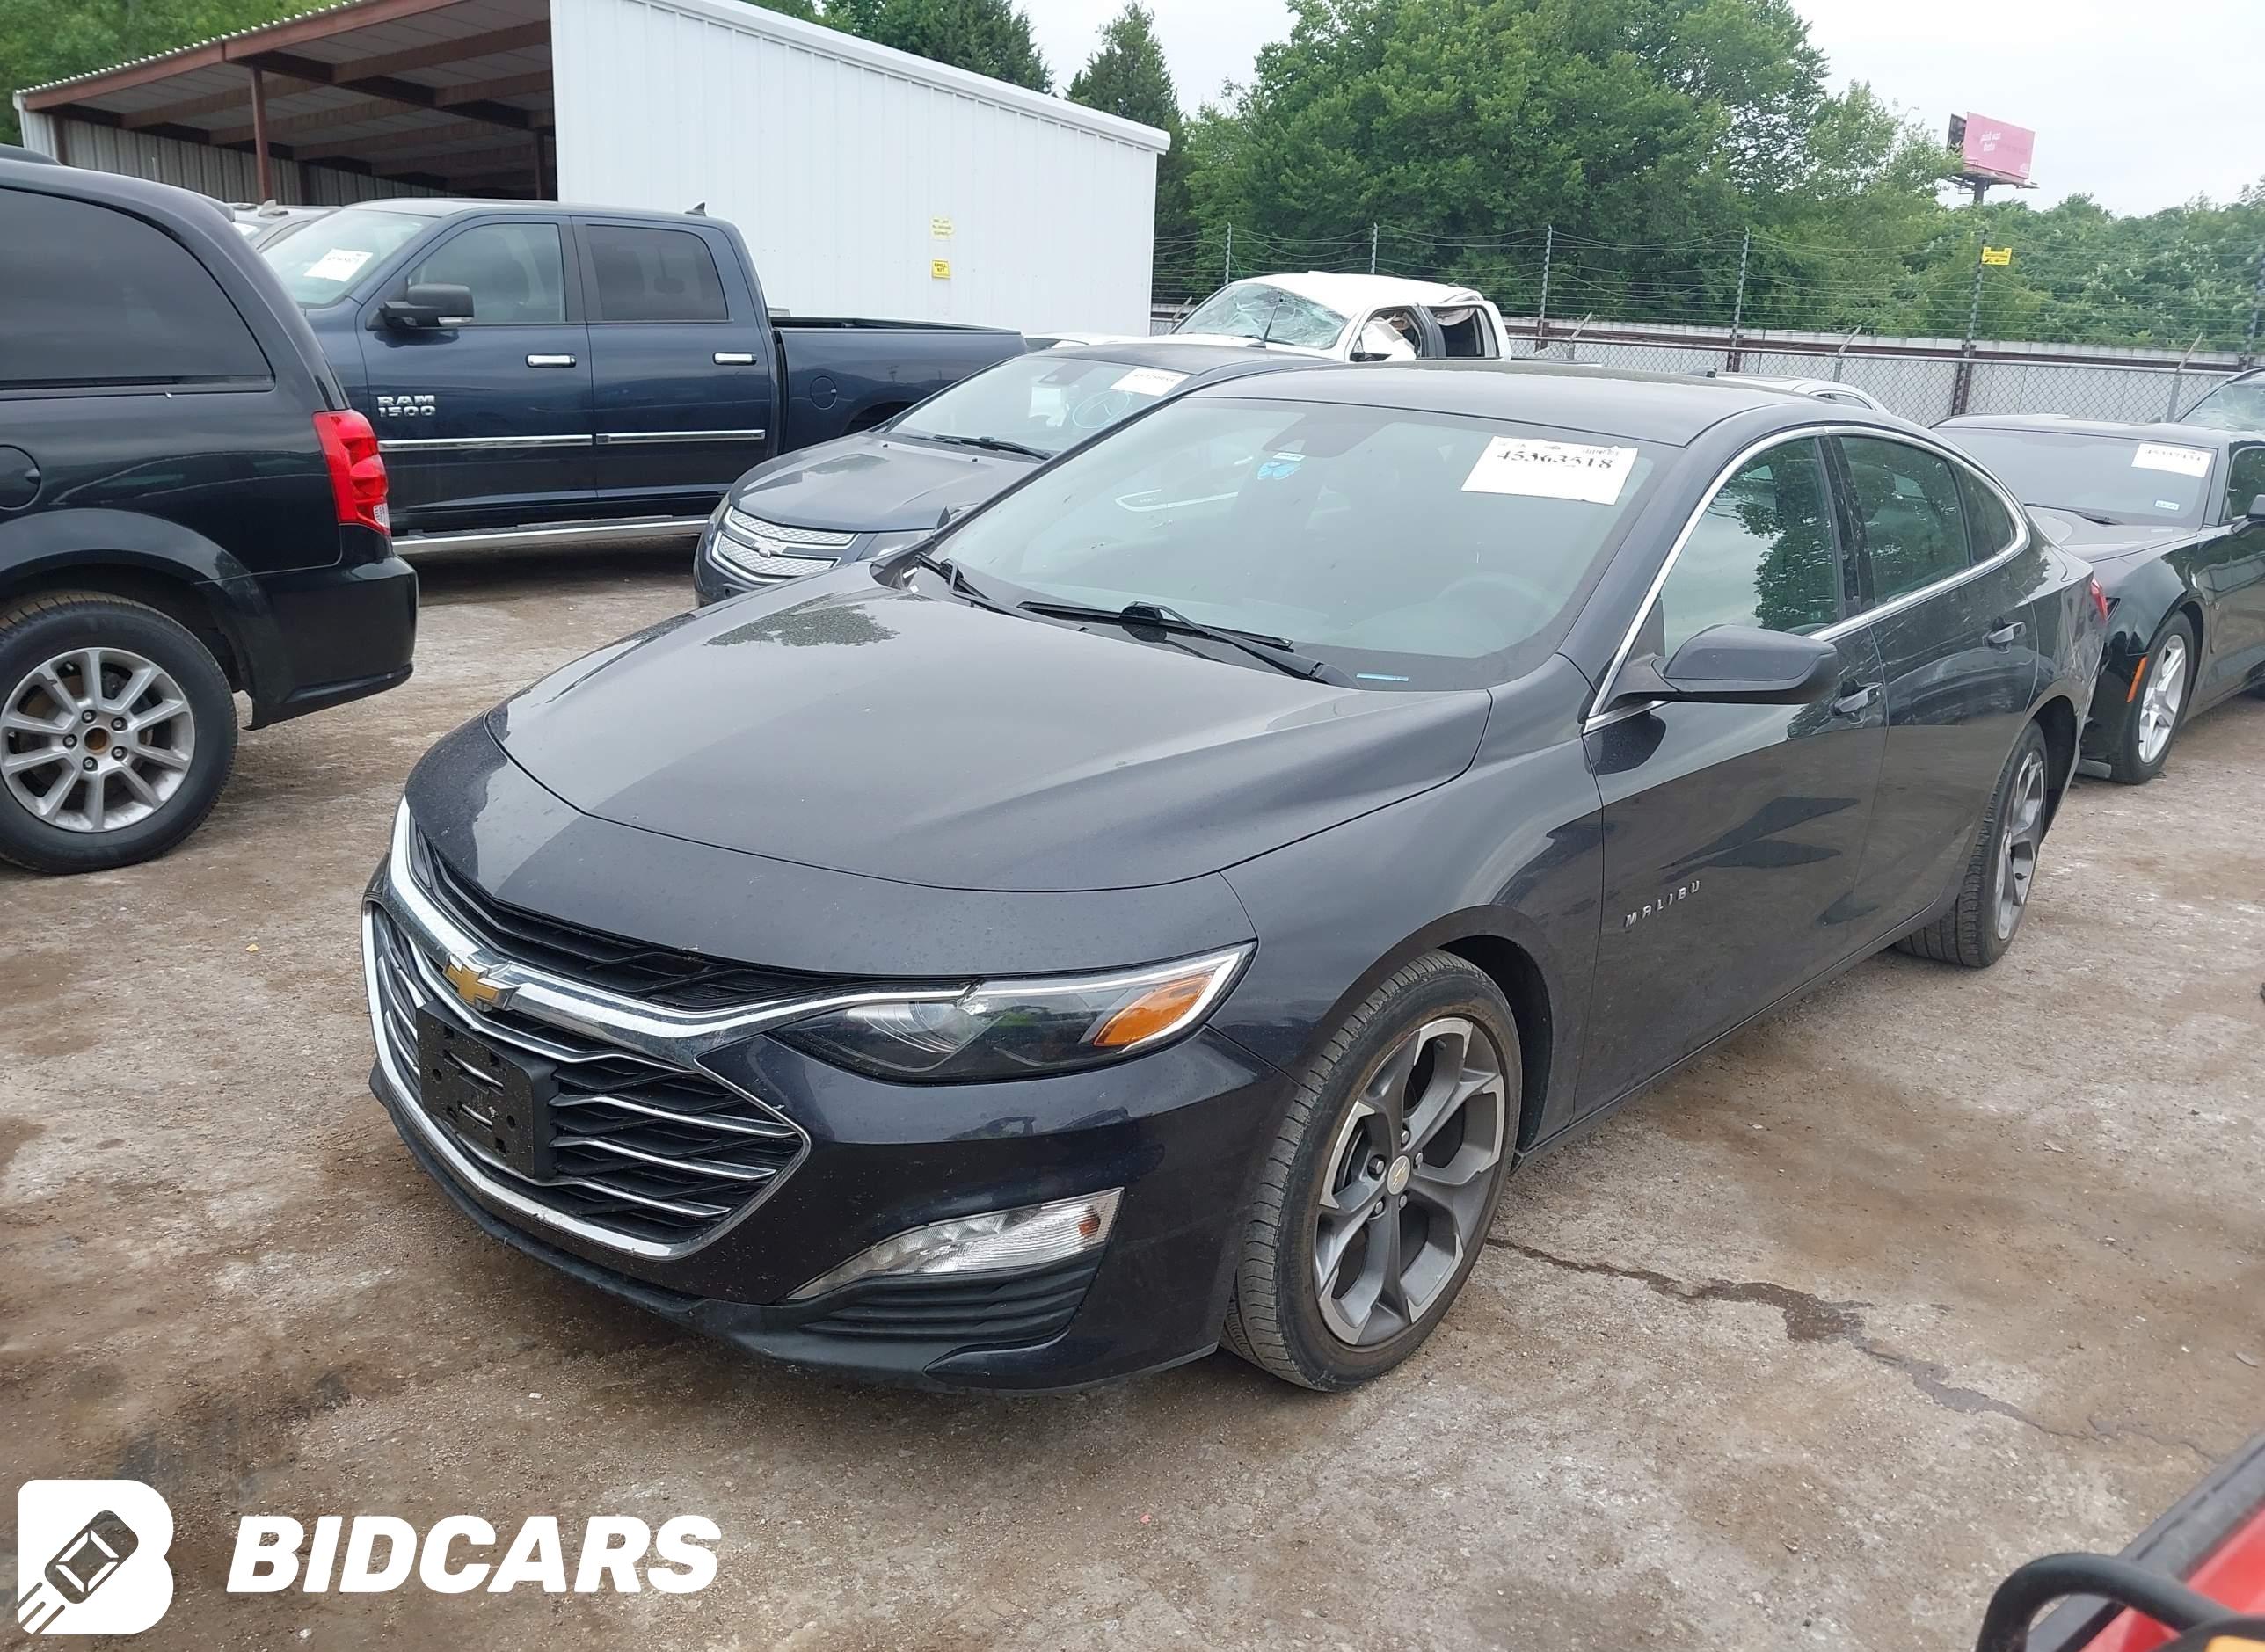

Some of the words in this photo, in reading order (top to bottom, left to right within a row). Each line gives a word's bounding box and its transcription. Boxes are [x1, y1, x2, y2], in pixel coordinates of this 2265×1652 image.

[377, 395, 435, 406] RAM
[378, 405, 436, 418] 1500
[1624, 880, 1700, 928] MALIBU
